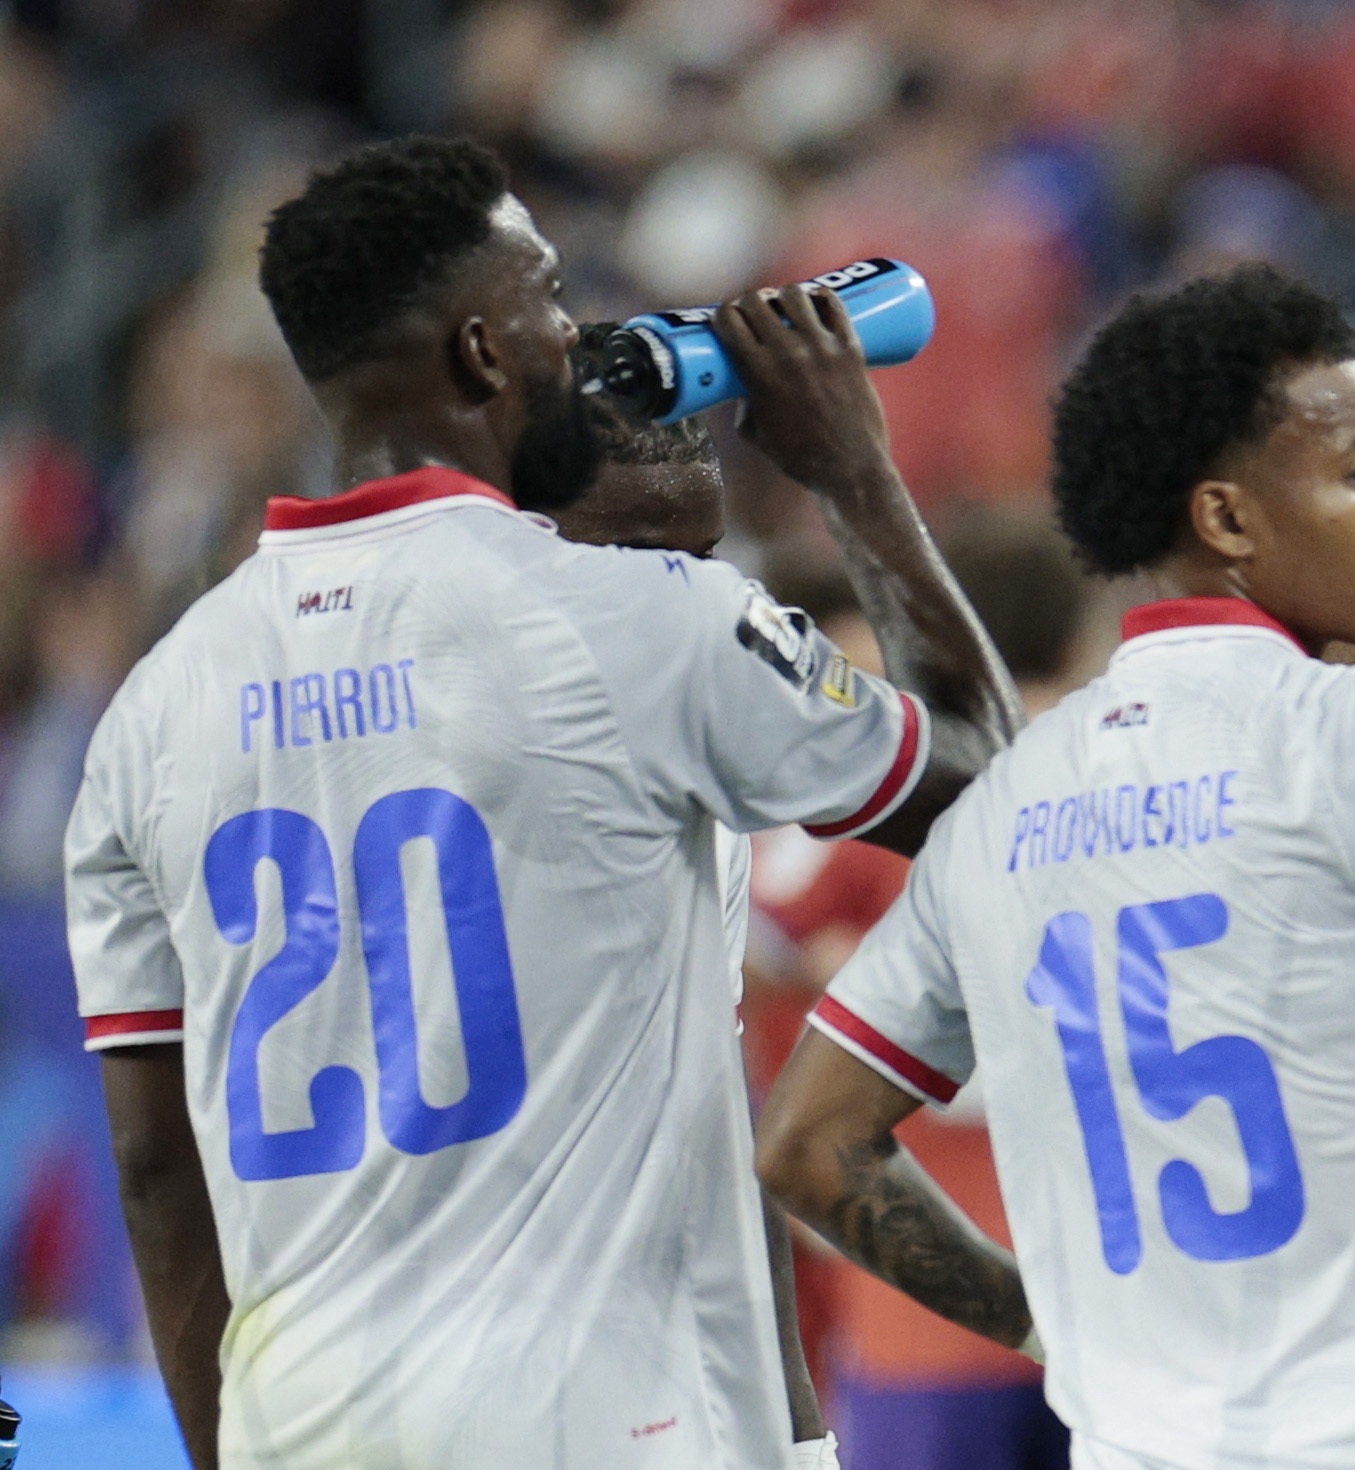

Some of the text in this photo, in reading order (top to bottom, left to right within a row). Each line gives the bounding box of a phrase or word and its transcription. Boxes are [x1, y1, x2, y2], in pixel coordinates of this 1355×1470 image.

[240, 658, 417, 755] PIERROT
[1007, 769, 1239, 873] PROVIDENCE
[204, 788, 527, 1181] 20
[1025, 892, 1305, 1277] 15
